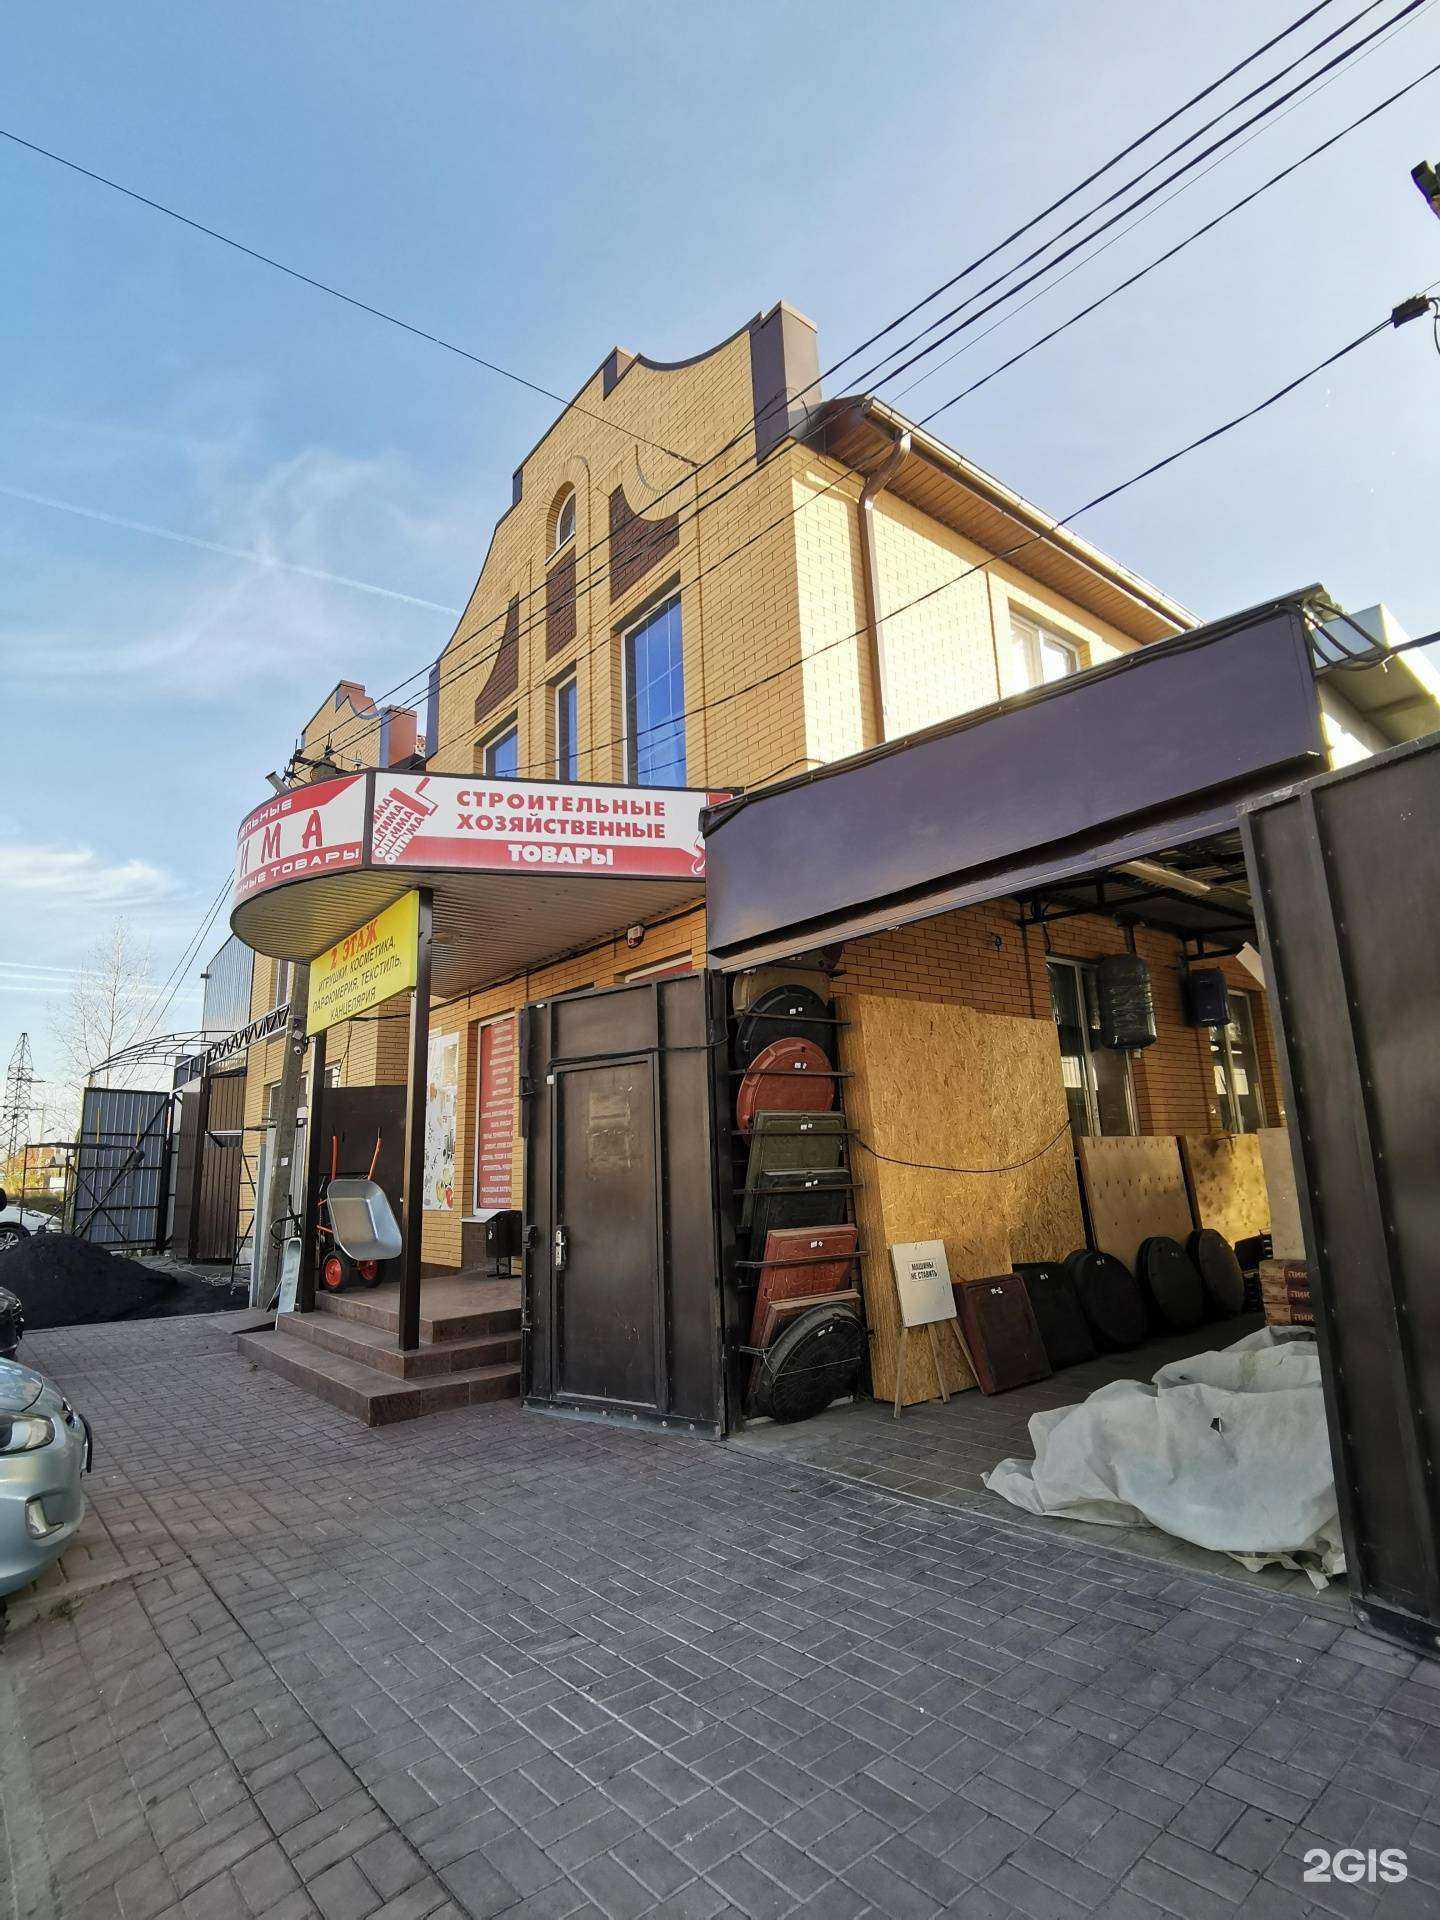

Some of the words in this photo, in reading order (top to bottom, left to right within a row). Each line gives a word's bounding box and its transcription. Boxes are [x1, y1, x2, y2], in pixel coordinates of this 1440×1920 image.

[456, 790, 665, 816] СТРОИТЕЛЬНЫЕ
[456, 814, 665, 839] ХОЗЯЙСТВЕННЫЕ
[270, 848, 360, 878] ТОВАРЫ
[507, 844, 615, 866] ТОВАРЫ
[343, 918, 378, 962] ЭТАЖ
[330, 986, 376, 1021] КАНЦЕЛЯРИЯ
